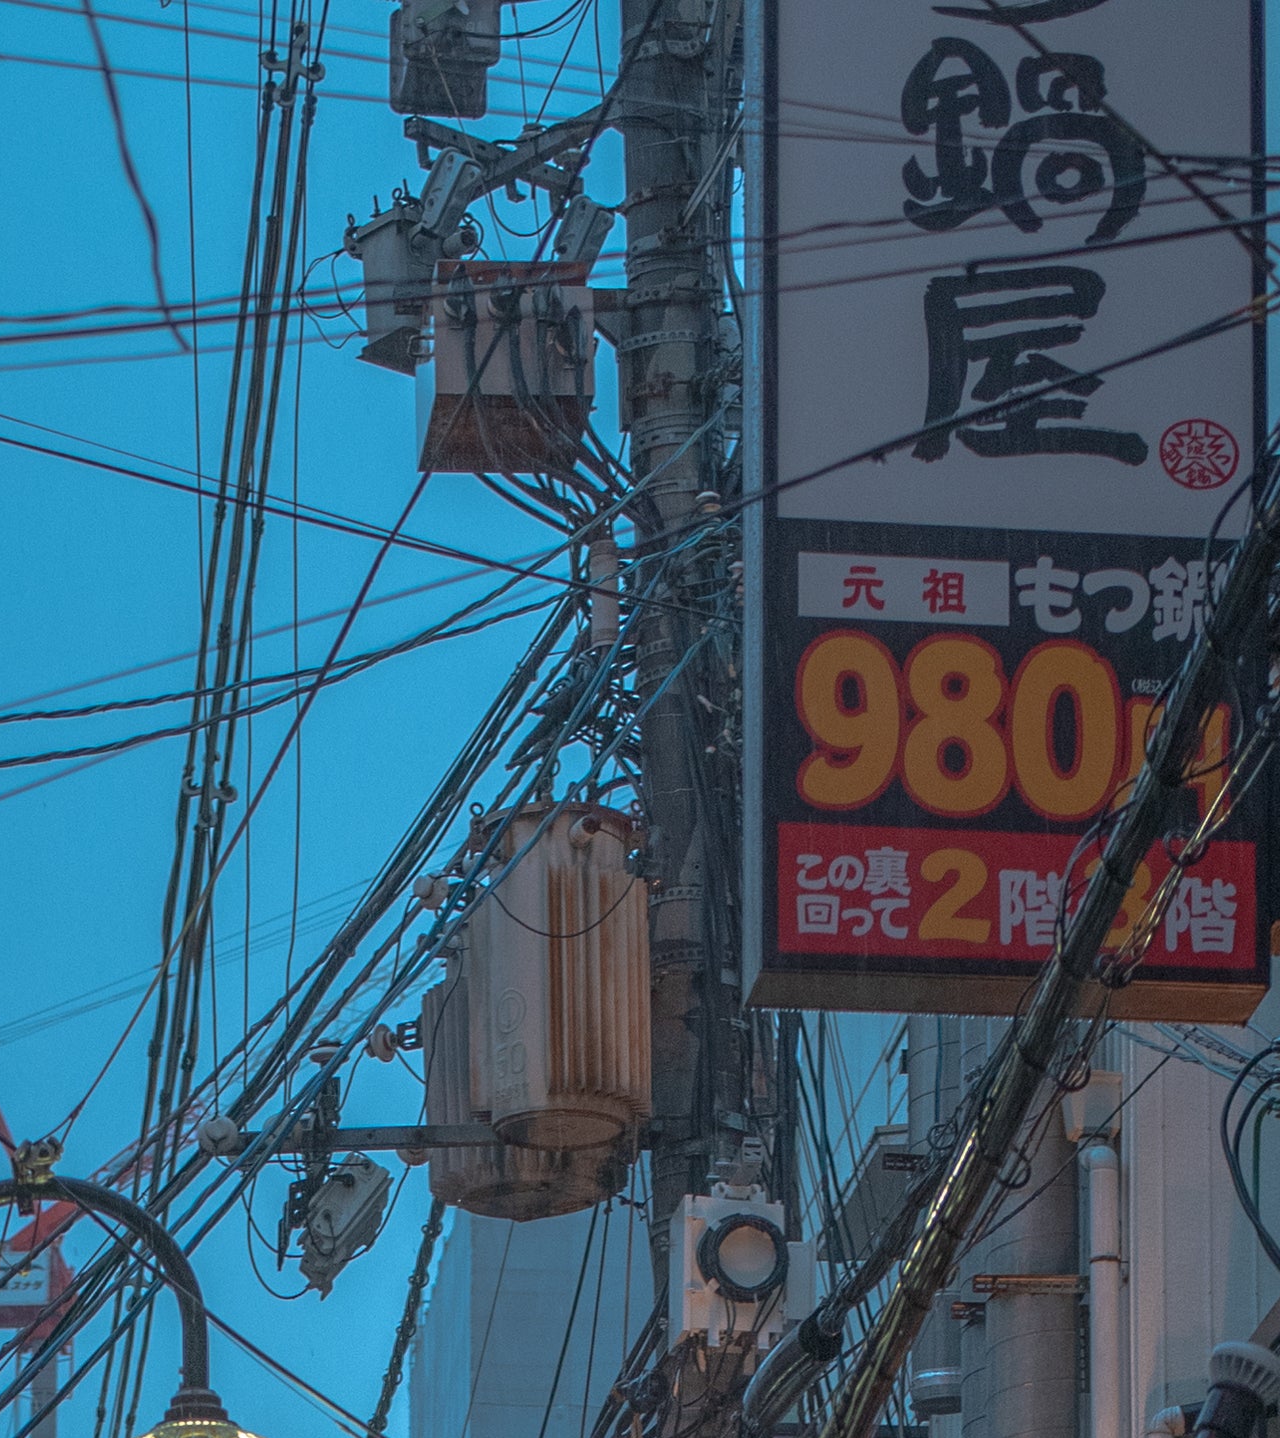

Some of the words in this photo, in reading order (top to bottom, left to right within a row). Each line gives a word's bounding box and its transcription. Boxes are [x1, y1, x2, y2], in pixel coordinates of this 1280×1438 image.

[900, 0, 1148, 466] 鍋屋
[842, 565, 967, 616] 元祖
[797, 848, 910, 894] この裏
[797, 895, 910, 940] 回って
